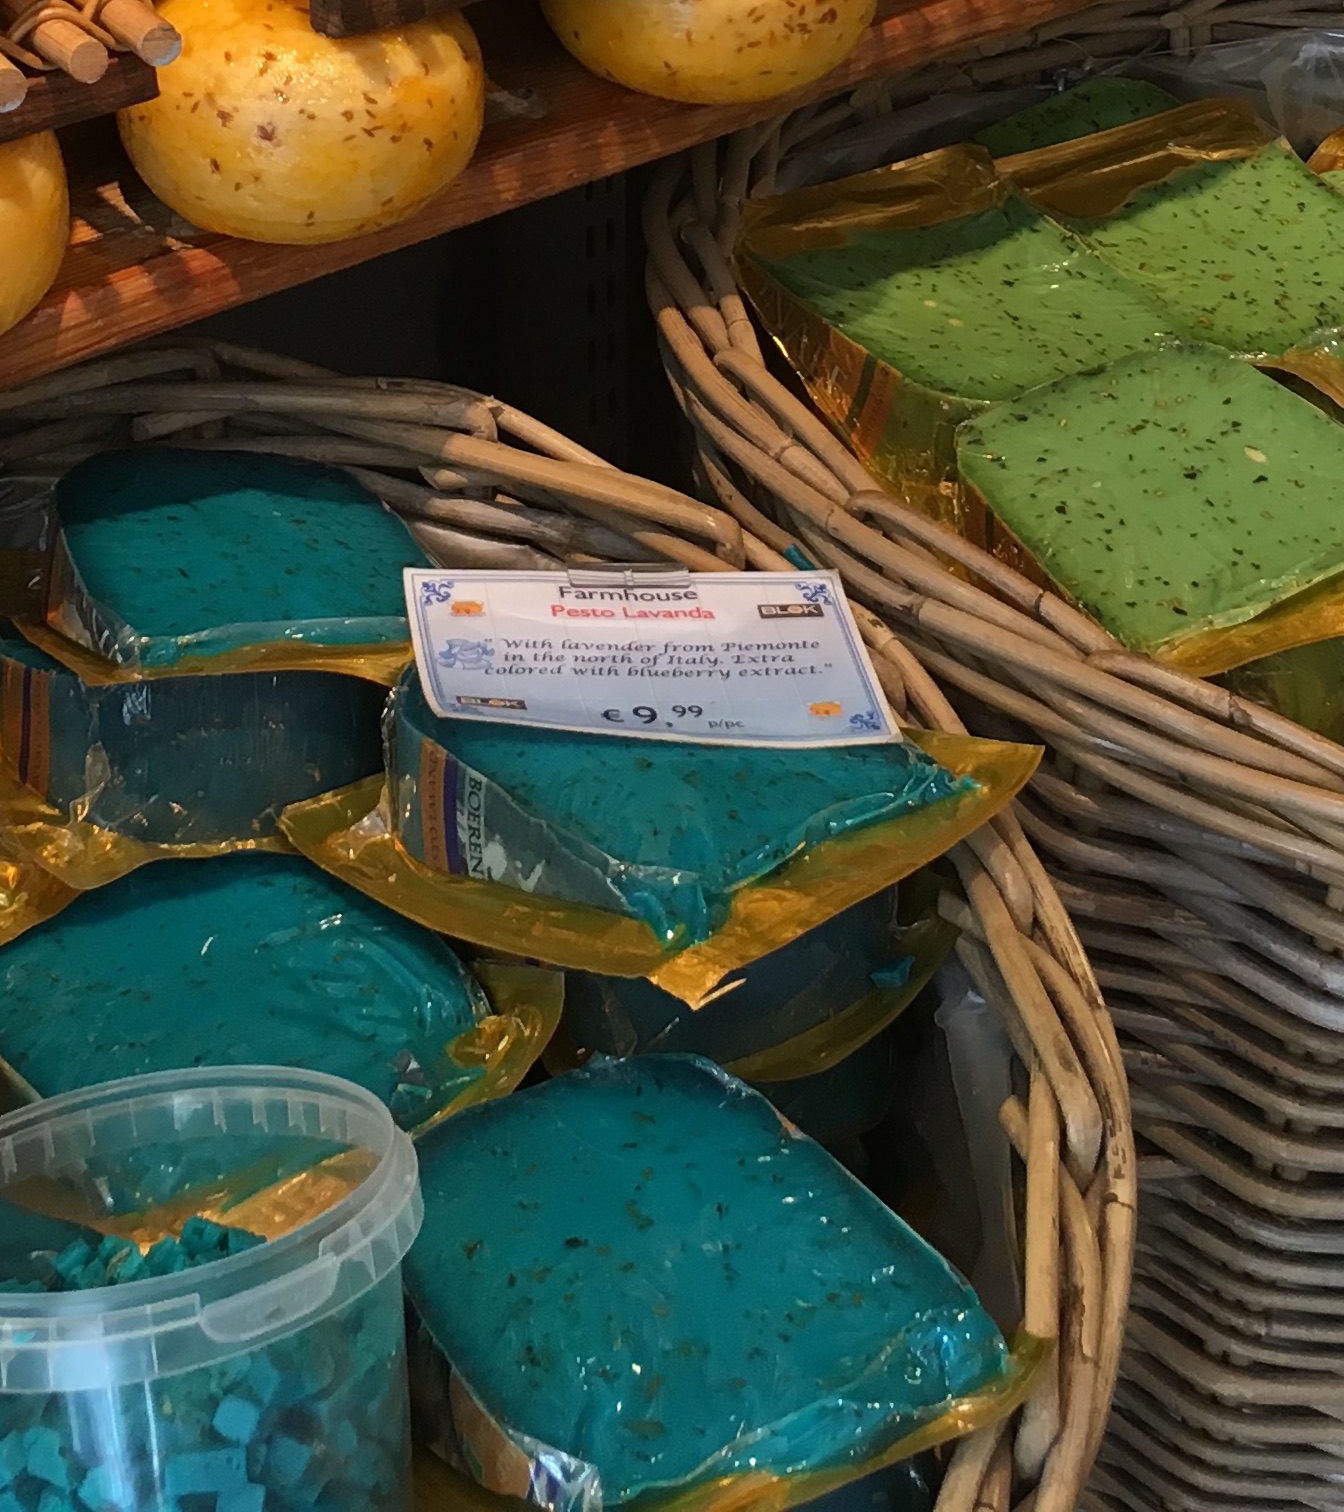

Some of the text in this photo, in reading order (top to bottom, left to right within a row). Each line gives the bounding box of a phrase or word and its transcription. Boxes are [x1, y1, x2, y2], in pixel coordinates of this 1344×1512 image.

[558, 586, 698, 602] Farmhouse
[550, 604, 716, 620] Pesto Lavanda
[759, 604, 820, 616] BLOK
[503, 638, 552, 650] With
[561, 638, 656, 652] lavender
[663, 641, 714, 655] from
[721, 640, 820, 652] Piemonte
[503, 650, 795, 667] in the north of Italy. Extra
[484, 663, 562, 676] colored
[570, 665, 619, 677] with
[627, 667, 731, 680] blueberry
